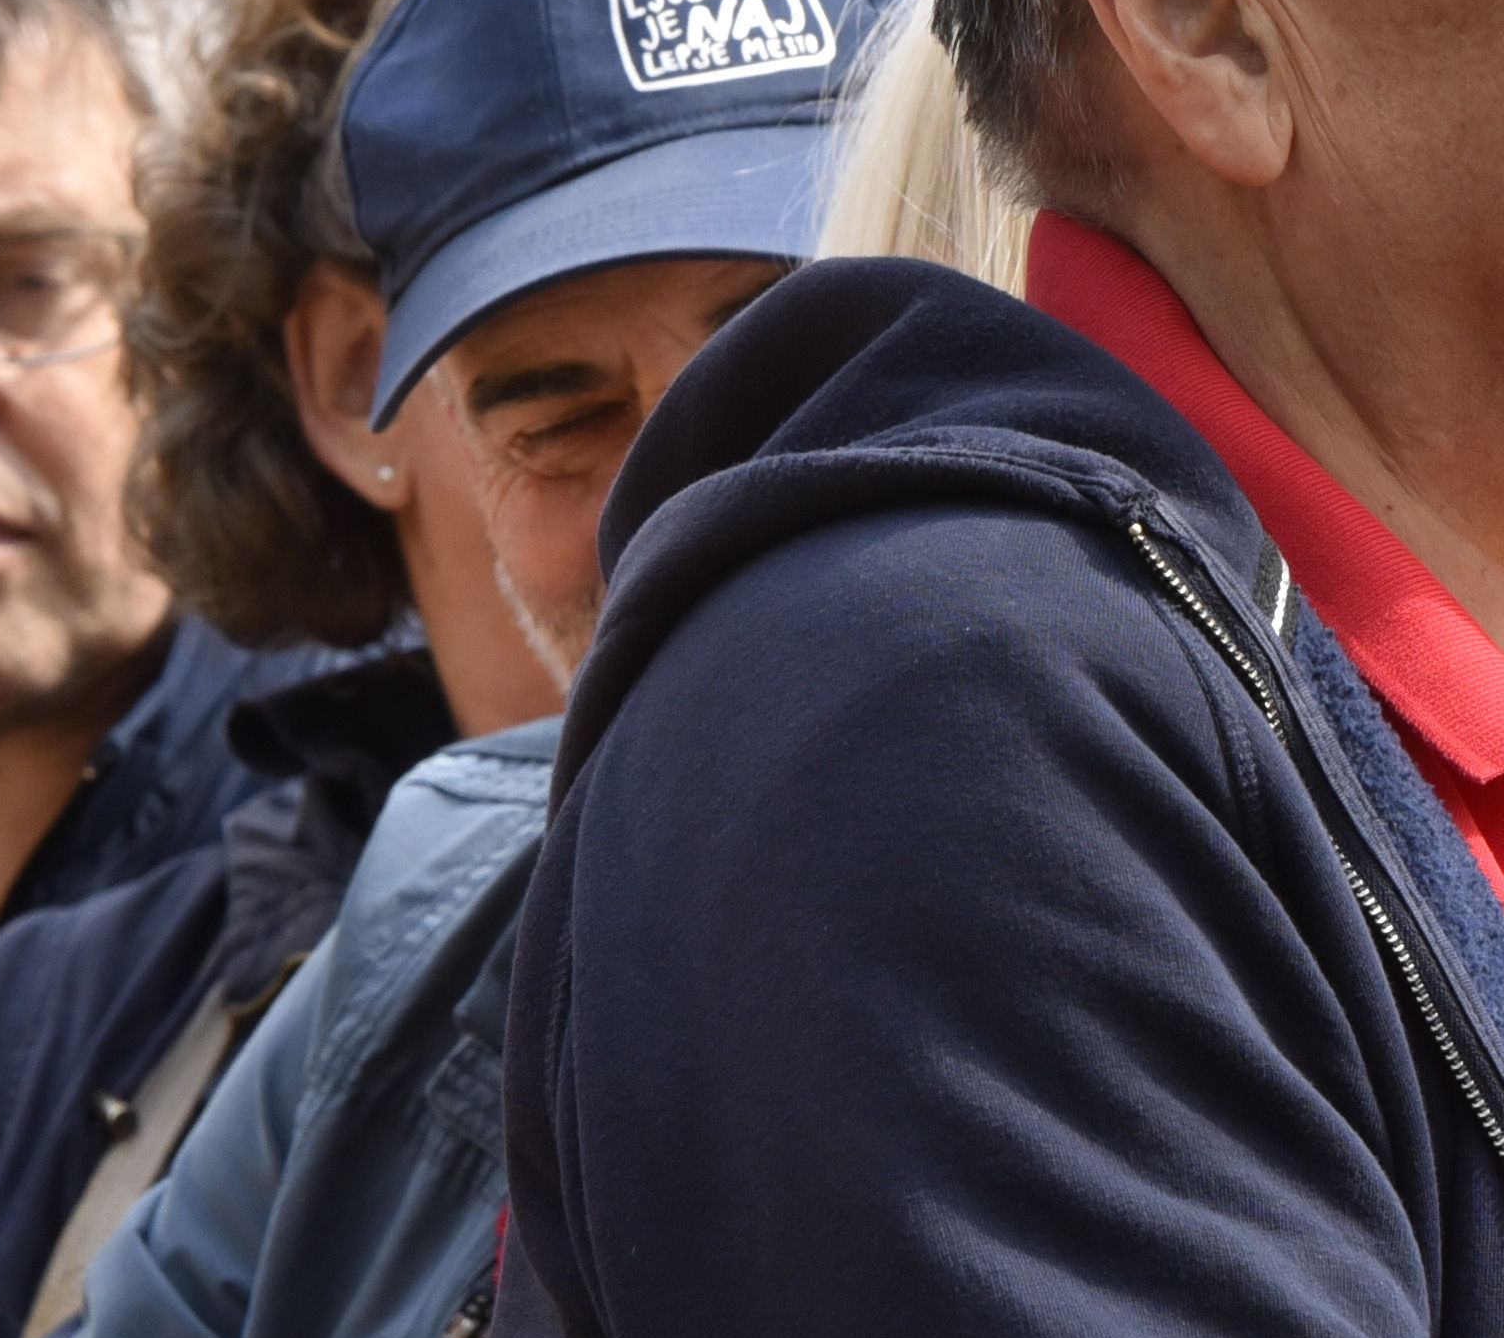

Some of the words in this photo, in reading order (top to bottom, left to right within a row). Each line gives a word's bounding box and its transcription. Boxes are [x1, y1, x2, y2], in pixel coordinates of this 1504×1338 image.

[639, 9, 683, 50] JE
[642, 37, 731, 77] LEPJE
[741, 33, 819, 63] MESTO
